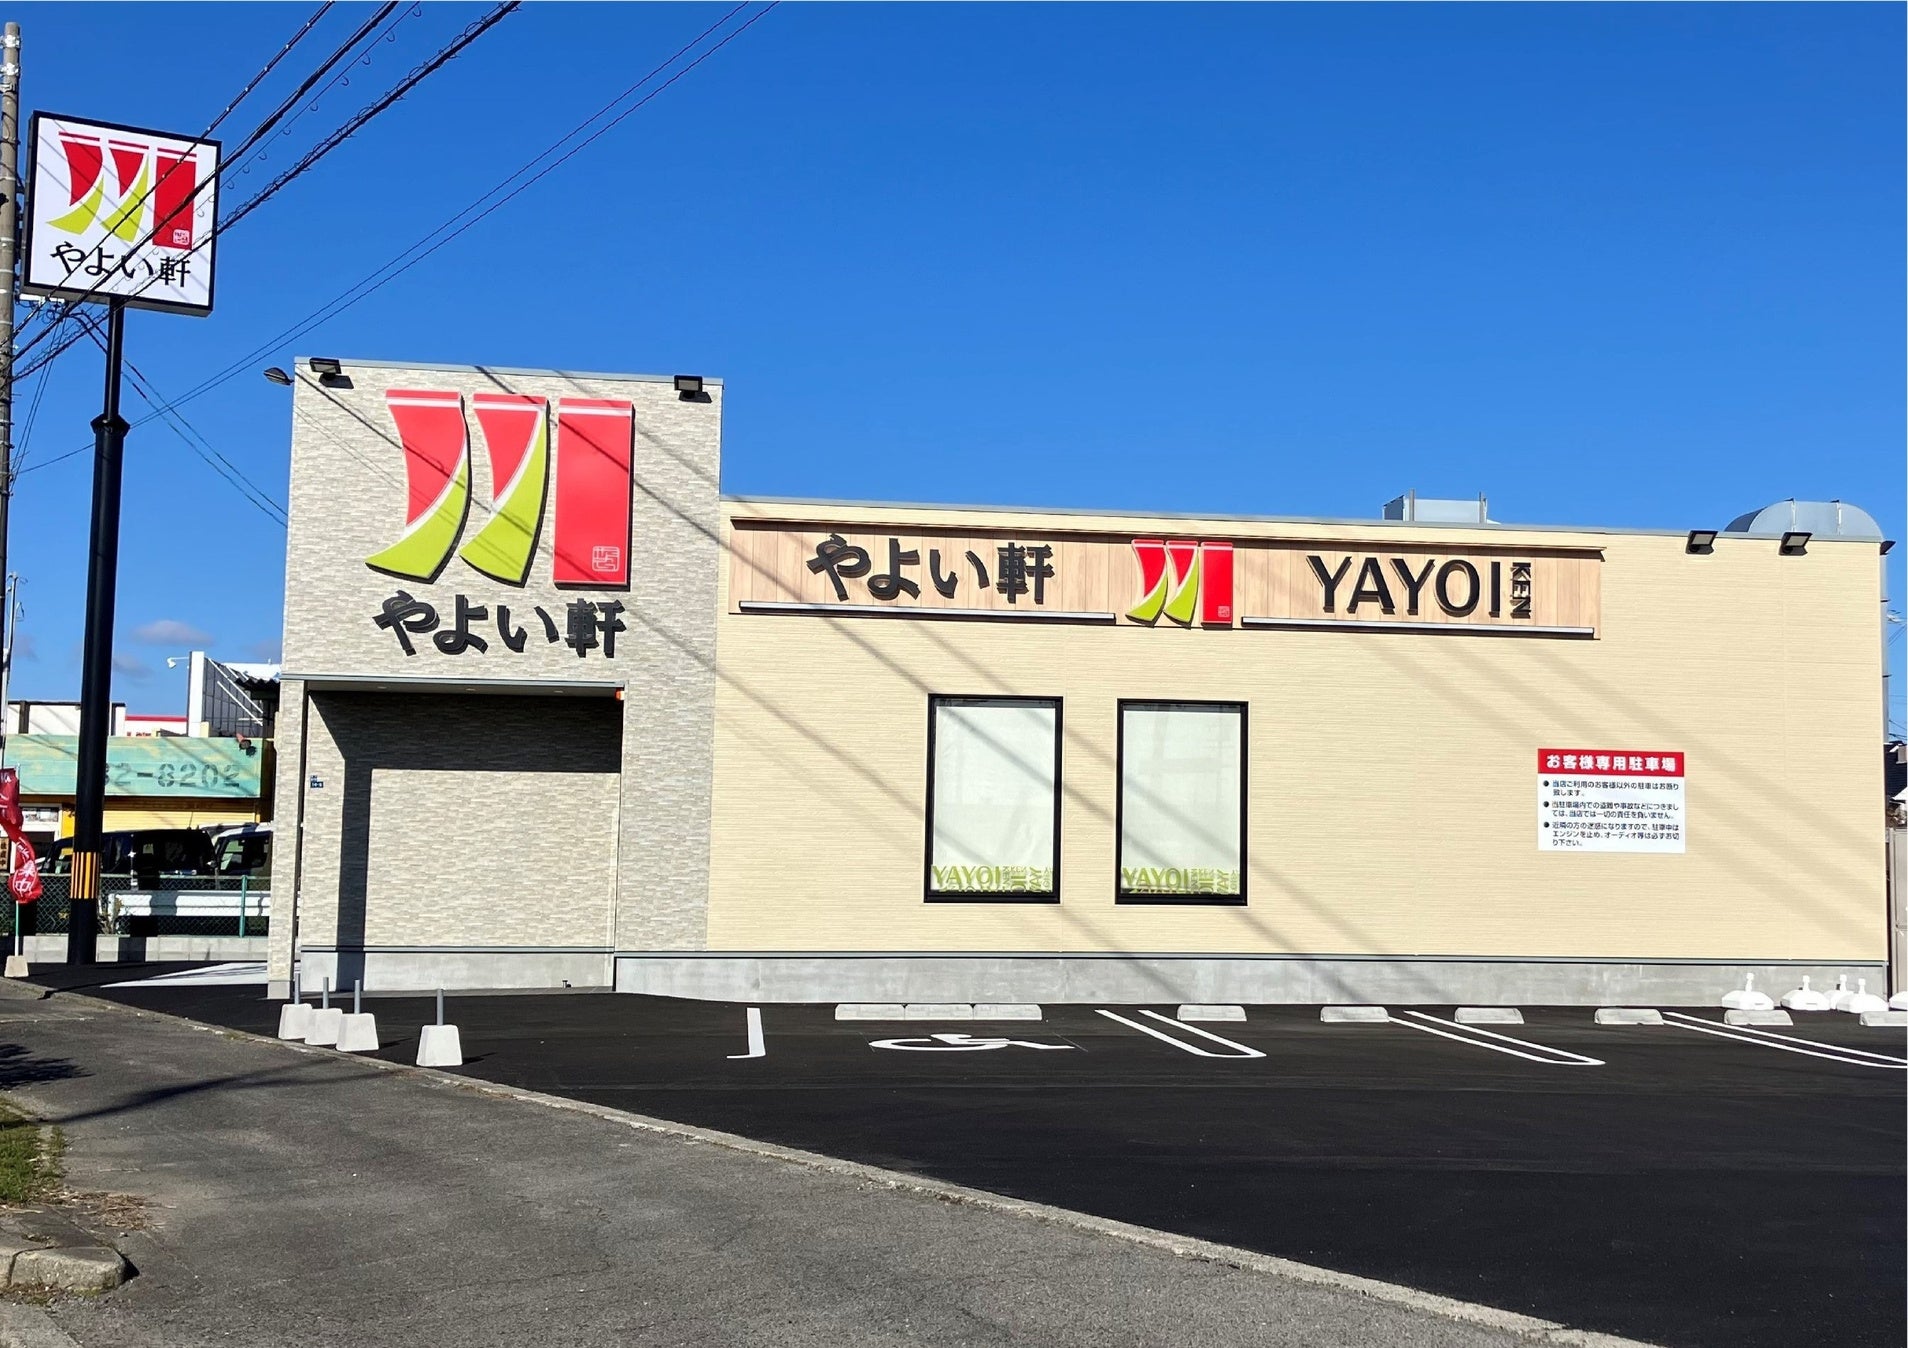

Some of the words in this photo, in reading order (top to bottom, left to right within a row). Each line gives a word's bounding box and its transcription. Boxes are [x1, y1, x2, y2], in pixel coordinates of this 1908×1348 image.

[51, 240, 191, 288] やよい軒
[806, 533, 1055, 605] やよい軒
[1306, 555, 1501, 618] YAYOI
[1510, 562, 1531, 619] KEN
[372, 590, 627, 658] やよい軒
[1546, 754, 1677, 772] お客様専用駐車場
[932, 865, 1001, 886] YAYOI
[1122, 867, 1189, 888] YAYOI
